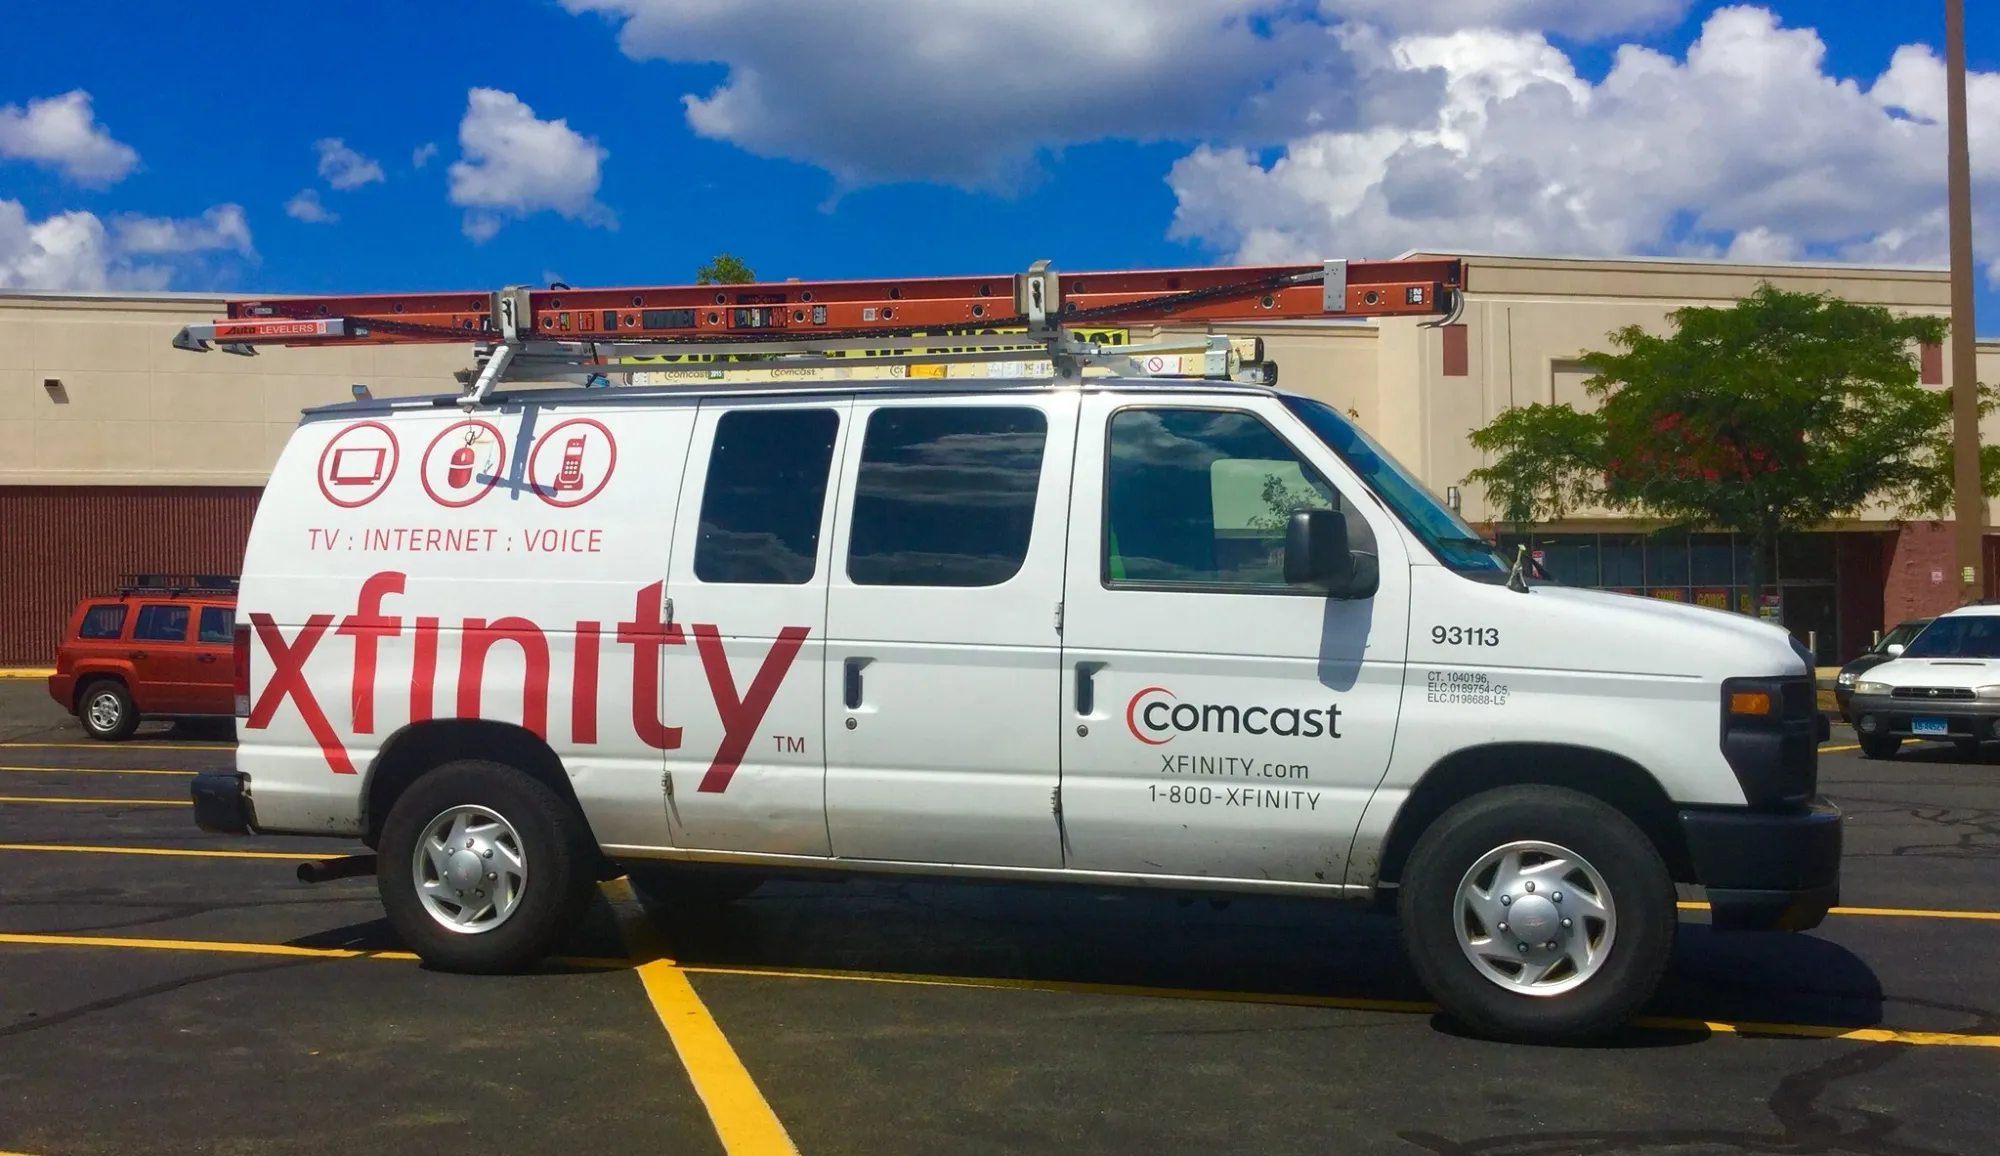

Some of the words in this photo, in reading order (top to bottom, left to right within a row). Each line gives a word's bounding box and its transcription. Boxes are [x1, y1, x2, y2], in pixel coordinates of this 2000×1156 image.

[224, 326, 256, 335] Auto
[260, 324, 314, 335] LEVELERS
[309, 528, 339, 551] TV
[363, 528, 498, 552] INTERNET
[524, 528, 603, 553] VOICE
[1431, 625, 1500, 647] 93113
[245, 570, 812, 793] xfinity
[1427, 671, 1444, 682] CT.
[1447, 672, 1490, 685] 1040196,
[1142, 701, 1342, 739] comcast
[773, 735, 805, 754] TM
[1161, 754, 1309, 780] XFINITY.com
[1148, 784, 1321, 811] 1-800-XFINITY
